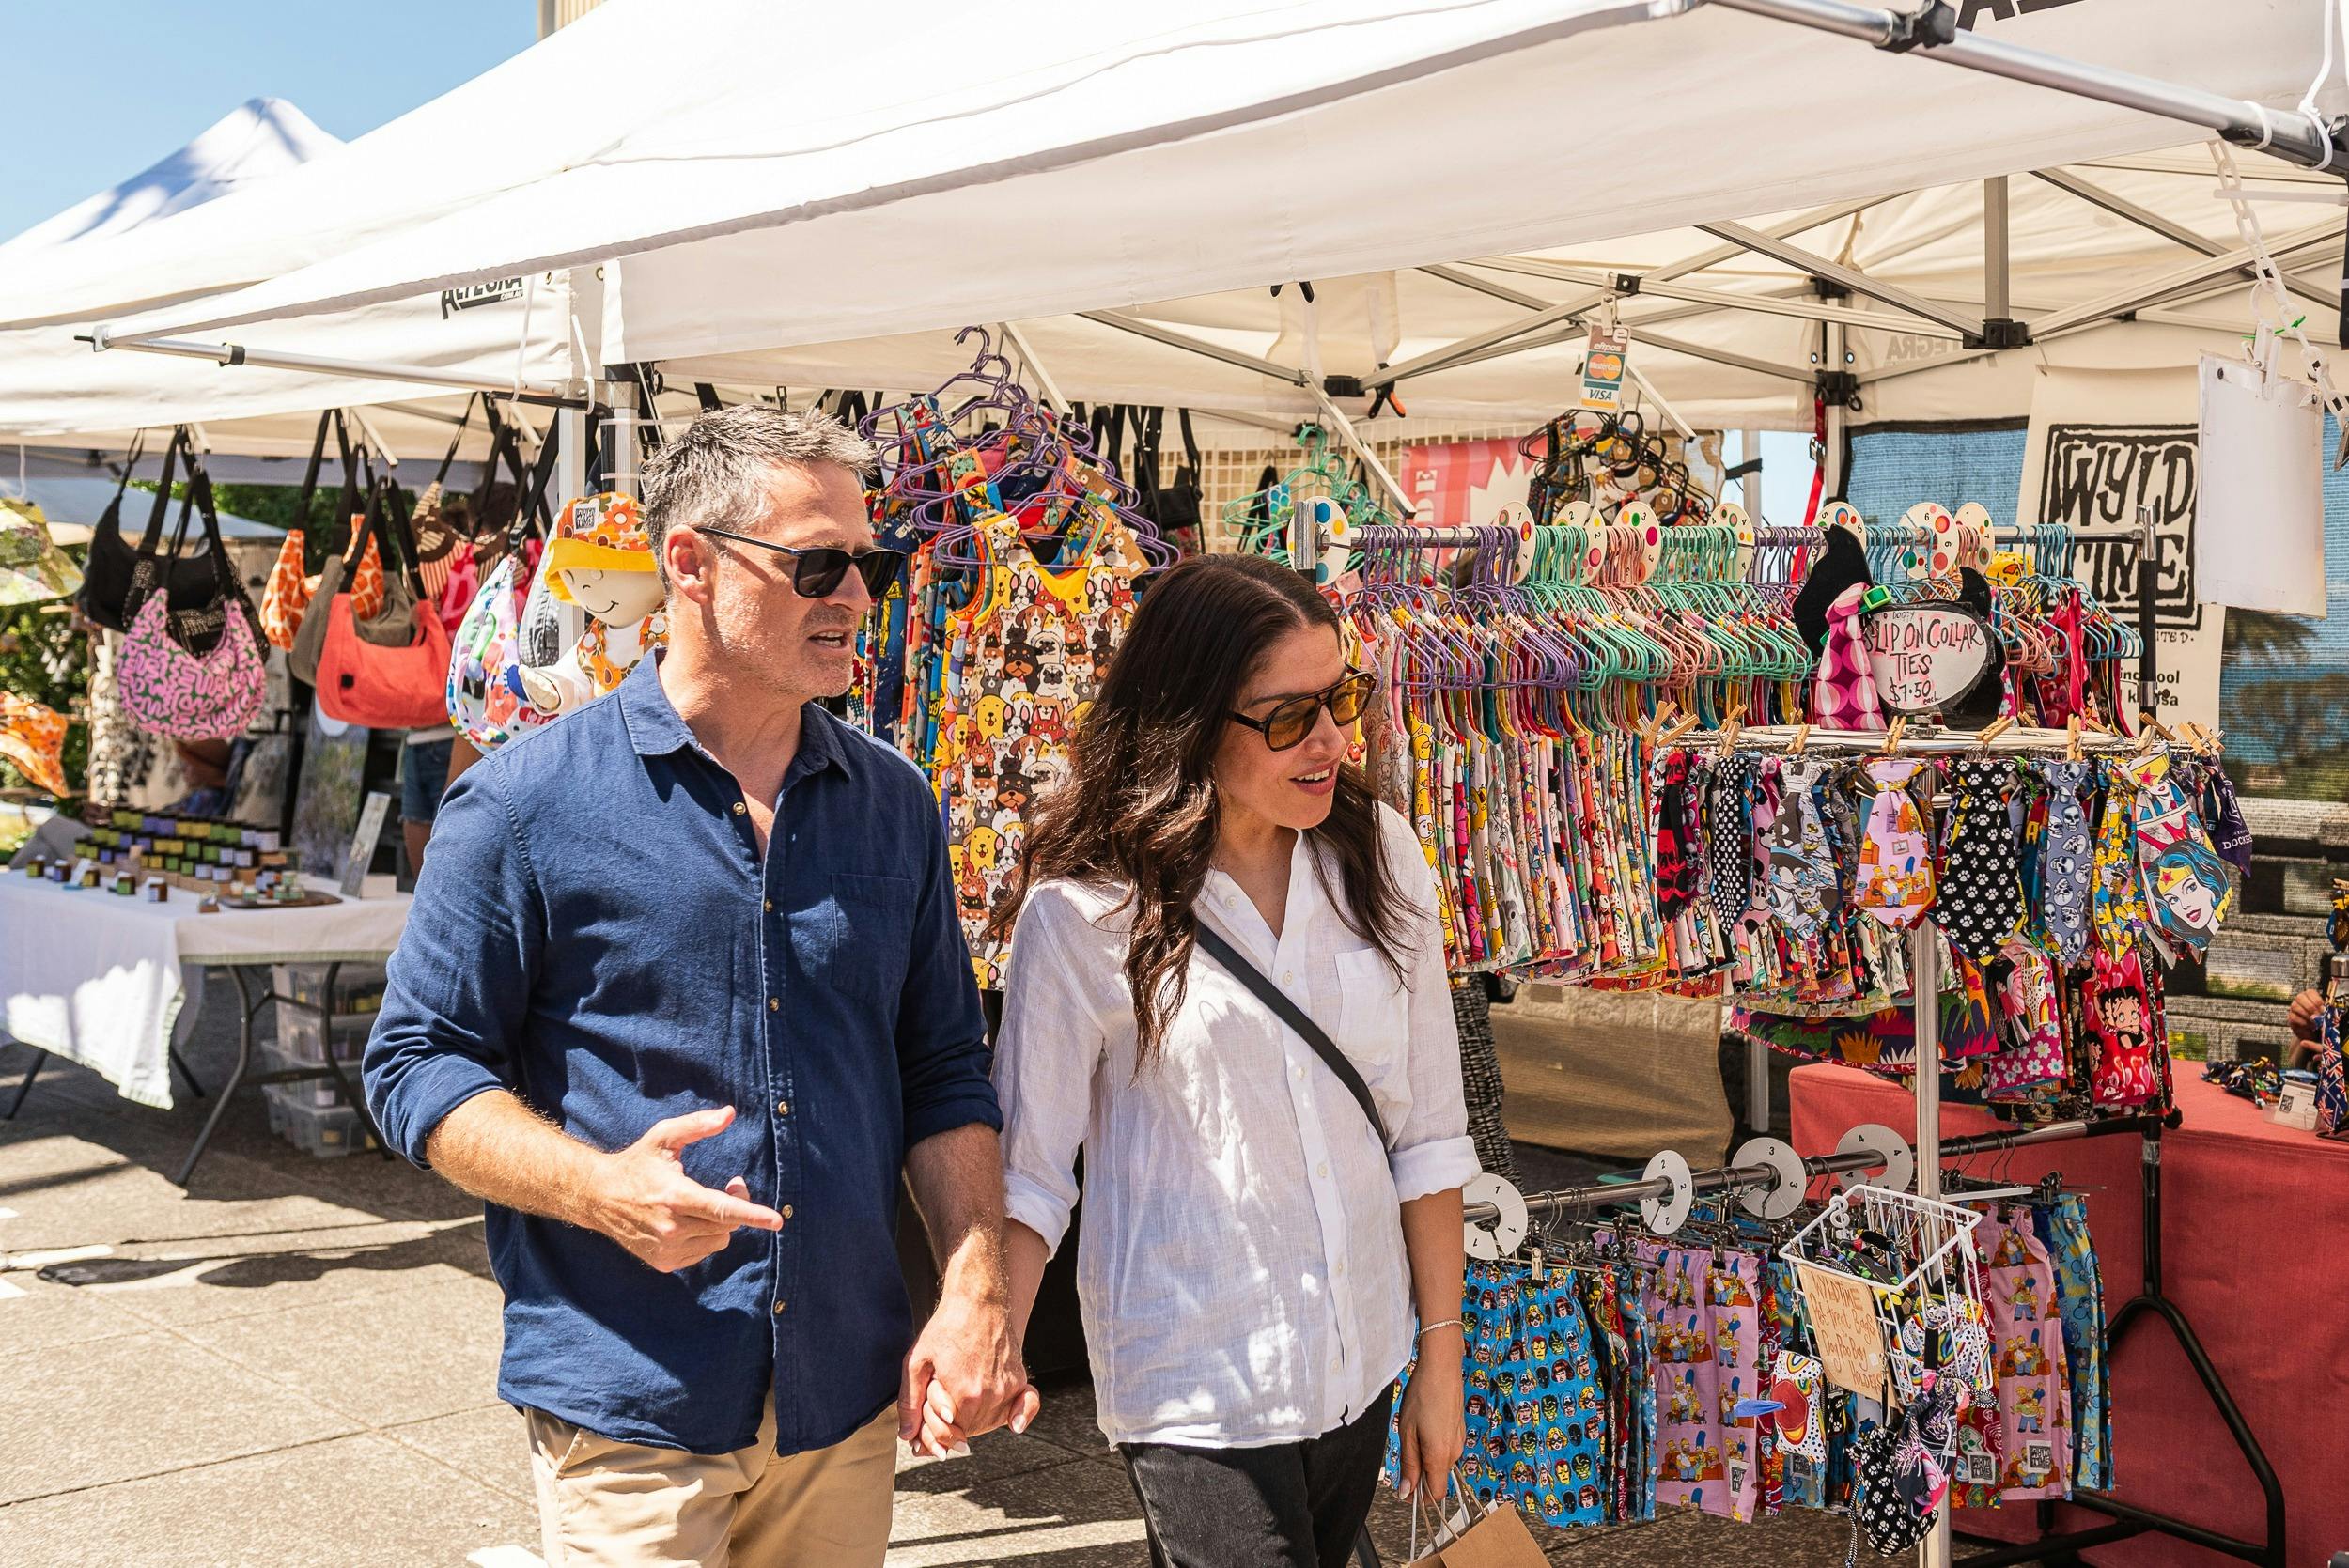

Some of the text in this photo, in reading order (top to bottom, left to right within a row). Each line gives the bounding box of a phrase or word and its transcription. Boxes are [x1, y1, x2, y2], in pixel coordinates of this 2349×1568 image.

[1590, 389, 1613, 401] VISA
[2062, 442, 2195, 527] WYLD
[1569, 511, 1575, 520] 2
[1641, 512, 1647, 521] 3
[1924, 513, 1930, 521] 6
[1892, 611, 1915, 620] DOGGY
[1927, 618, 1984, 653] COLLAR
[1889, 676, 1931, 707] $7.50
[1923, 691, 1942, 705] each
[1769, 1146, 1775, 1156] 3
[1660, 1159, 1666, 1170] 2
